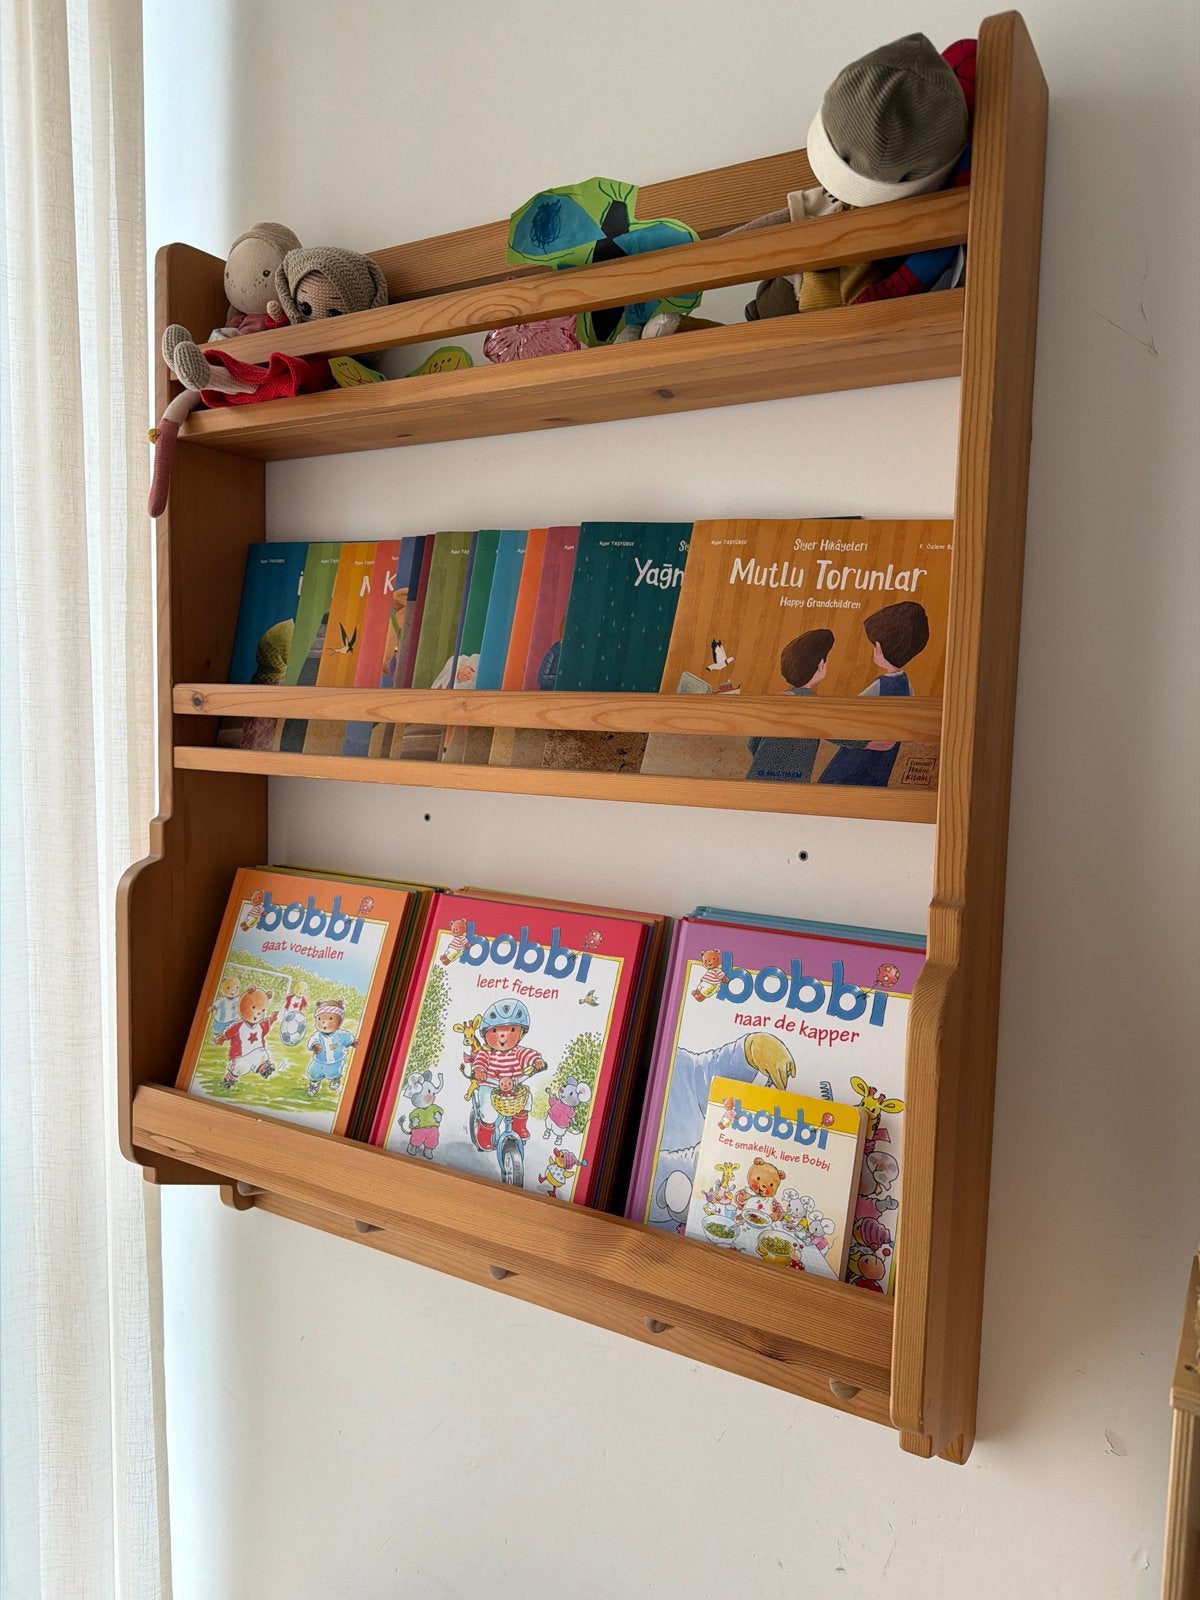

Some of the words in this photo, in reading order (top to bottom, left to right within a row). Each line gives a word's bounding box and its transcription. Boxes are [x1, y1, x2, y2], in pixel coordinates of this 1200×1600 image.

[794, 538, 819, 552] Siyer
[820, 539, 869, 553] Hikâyeleri
[729, 557, 804, 589] Mutlu
[816, 559, 928, 593] Torunlar
[780, 596, 805, 608] Happy
[806, 597, 862, 609] Grandchildren
[256, 891, 366, 945] bobbi
[262, 938, 288, 952] gaat
[289, 941, 344, 960] voetballen
[458, 921, 594, 984] bobbi
[476, 974, 509, 990] leert
[512, 977, 560, 999] fietsen
[716, 951, 889, 1027] bobbi
[734, 1012, 772, 1028] naar
[774, 1014, 796, 1032] de
[798, 1020, 860, 1047] kapper
[731, 1098, 830, 1151] bobbi
[718, 1133, 734, 1147] Eet
[735, 1141, 778, 1159] smakelijk,
[780, 1150, 801, 1163] lieve
[802, 1154, 831, 1172] Bobbi
